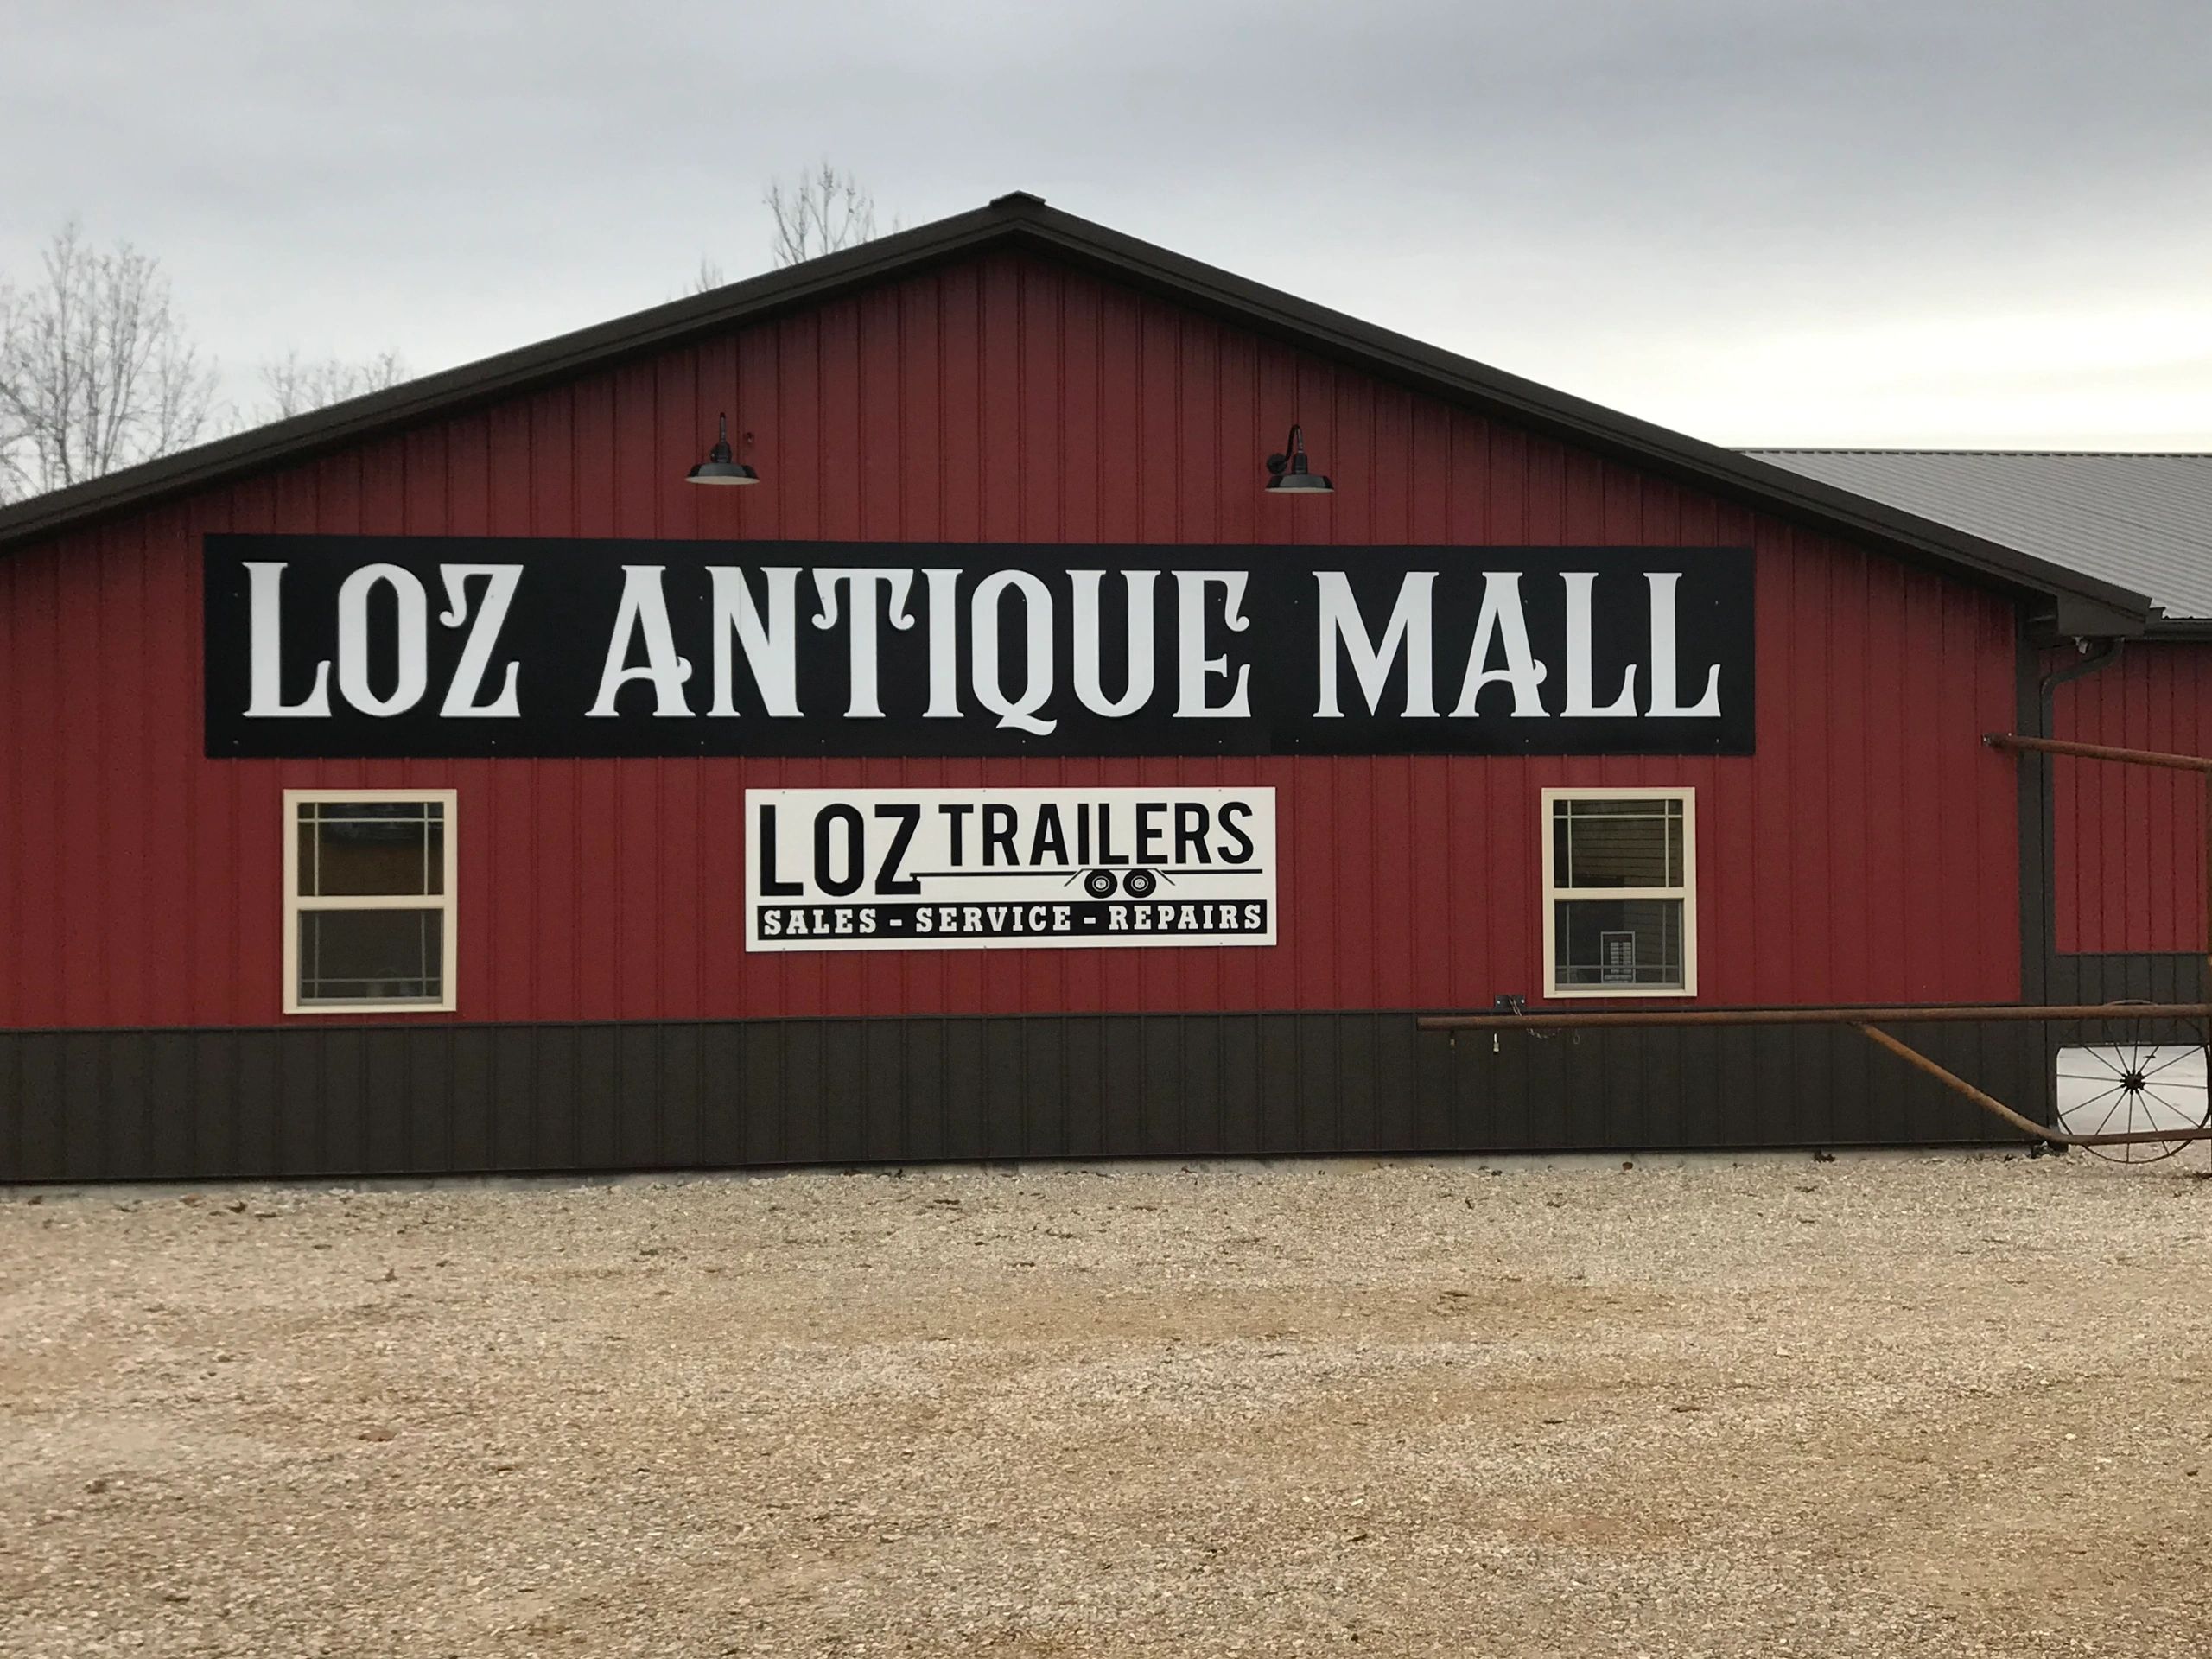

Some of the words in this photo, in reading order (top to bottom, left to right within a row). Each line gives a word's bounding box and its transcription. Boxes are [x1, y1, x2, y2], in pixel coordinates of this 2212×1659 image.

[242, 561, 524, 718] LOZ
[584, 564, 1252, 736] ANTIQUE
[1312, 571, 1722, 719] MALL
[759, 802, 922, 898] LOZ
[938, 800, 1255, 868] TRAILERS
[763, 906, 877, 936] SALES
[915, 904, 1071, 933] SERVICE
[1108, 901, 1262, 931] REPAIRS
